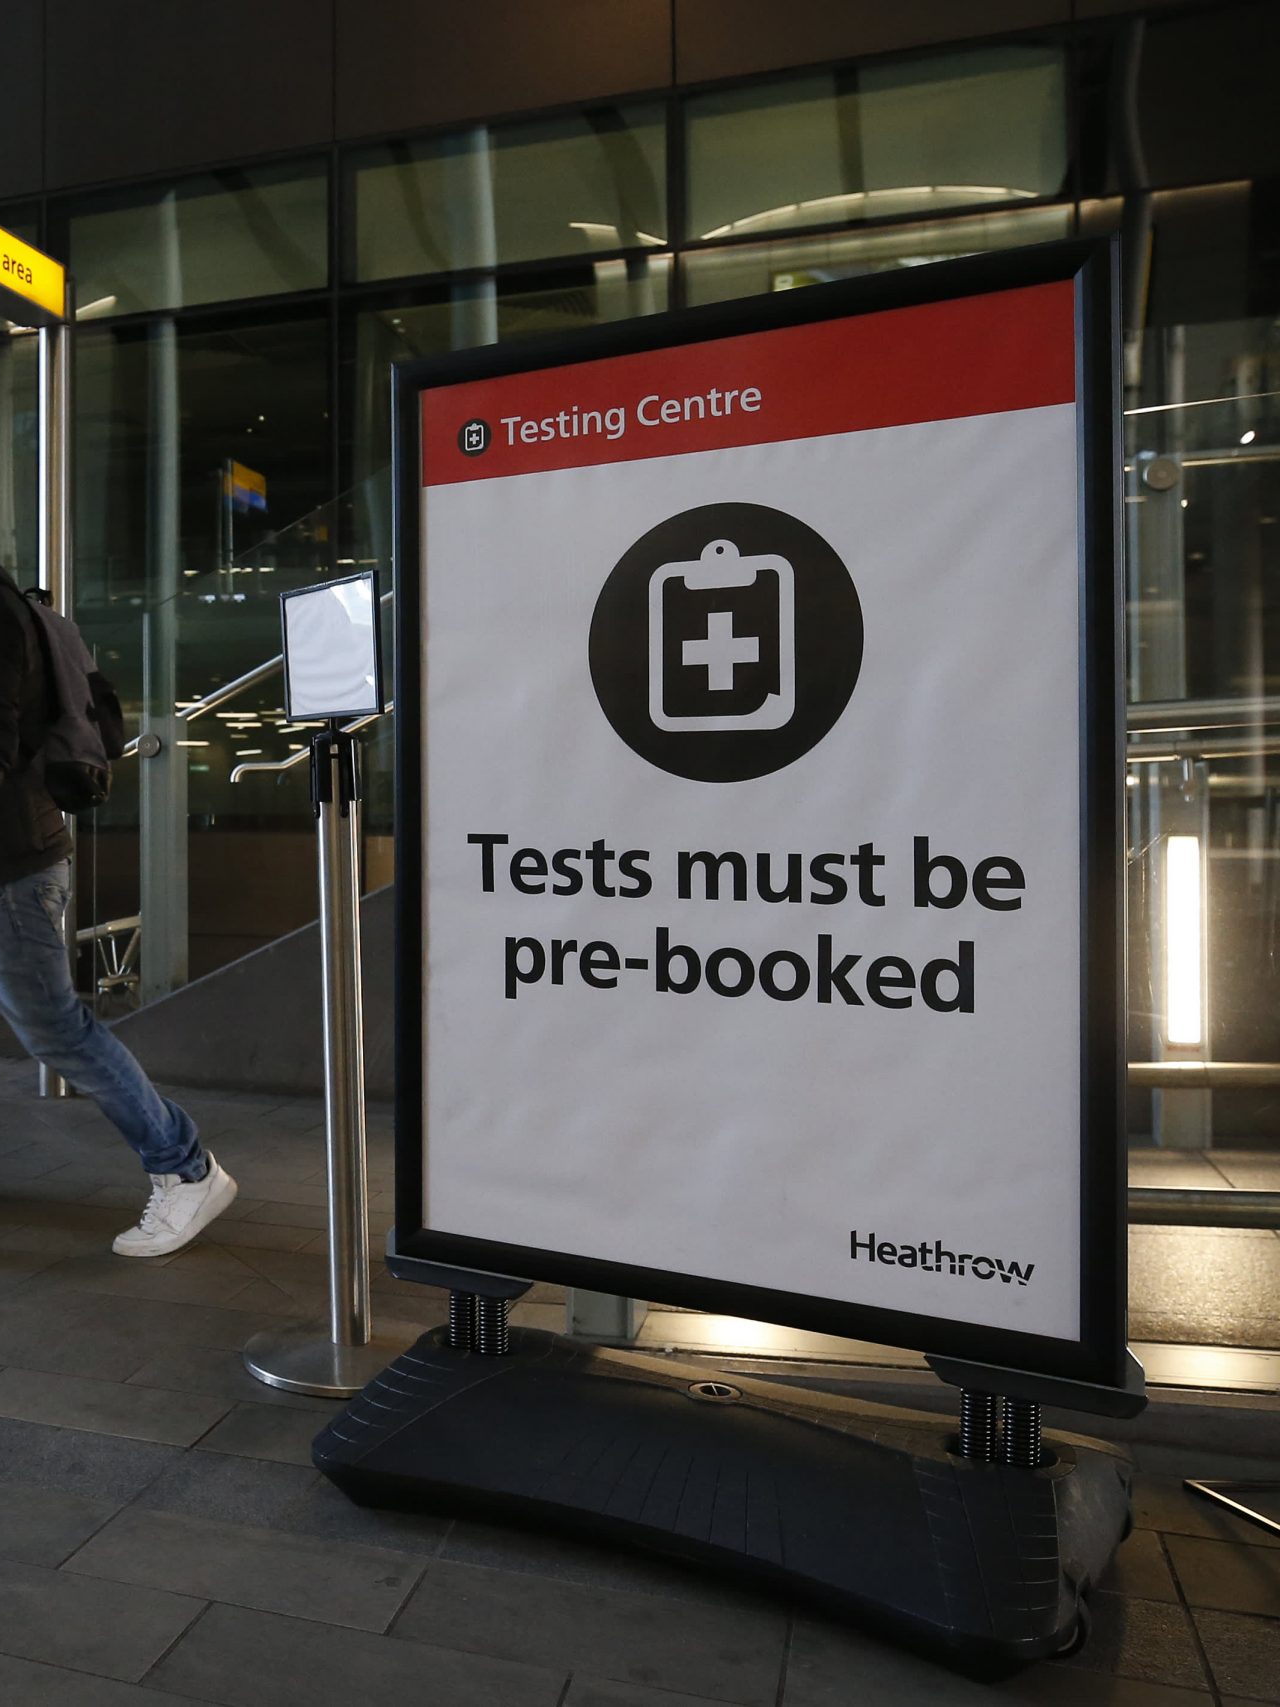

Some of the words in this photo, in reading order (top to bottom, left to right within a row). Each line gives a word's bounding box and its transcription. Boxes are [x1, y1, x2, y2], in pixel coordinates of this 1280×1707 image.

[2, 254, 33, 285] area
[501, 405, 625, 440] Testing
[637, 387, 762, 426] Centre
[468, 834, 653, 899] Tests
[678, 843, 886, 907] must
[914, 836, 1026, 912] be
[505, 927, 975, 1014] pre-booked
[850, 1229, 1036, 1287] Heathrow
